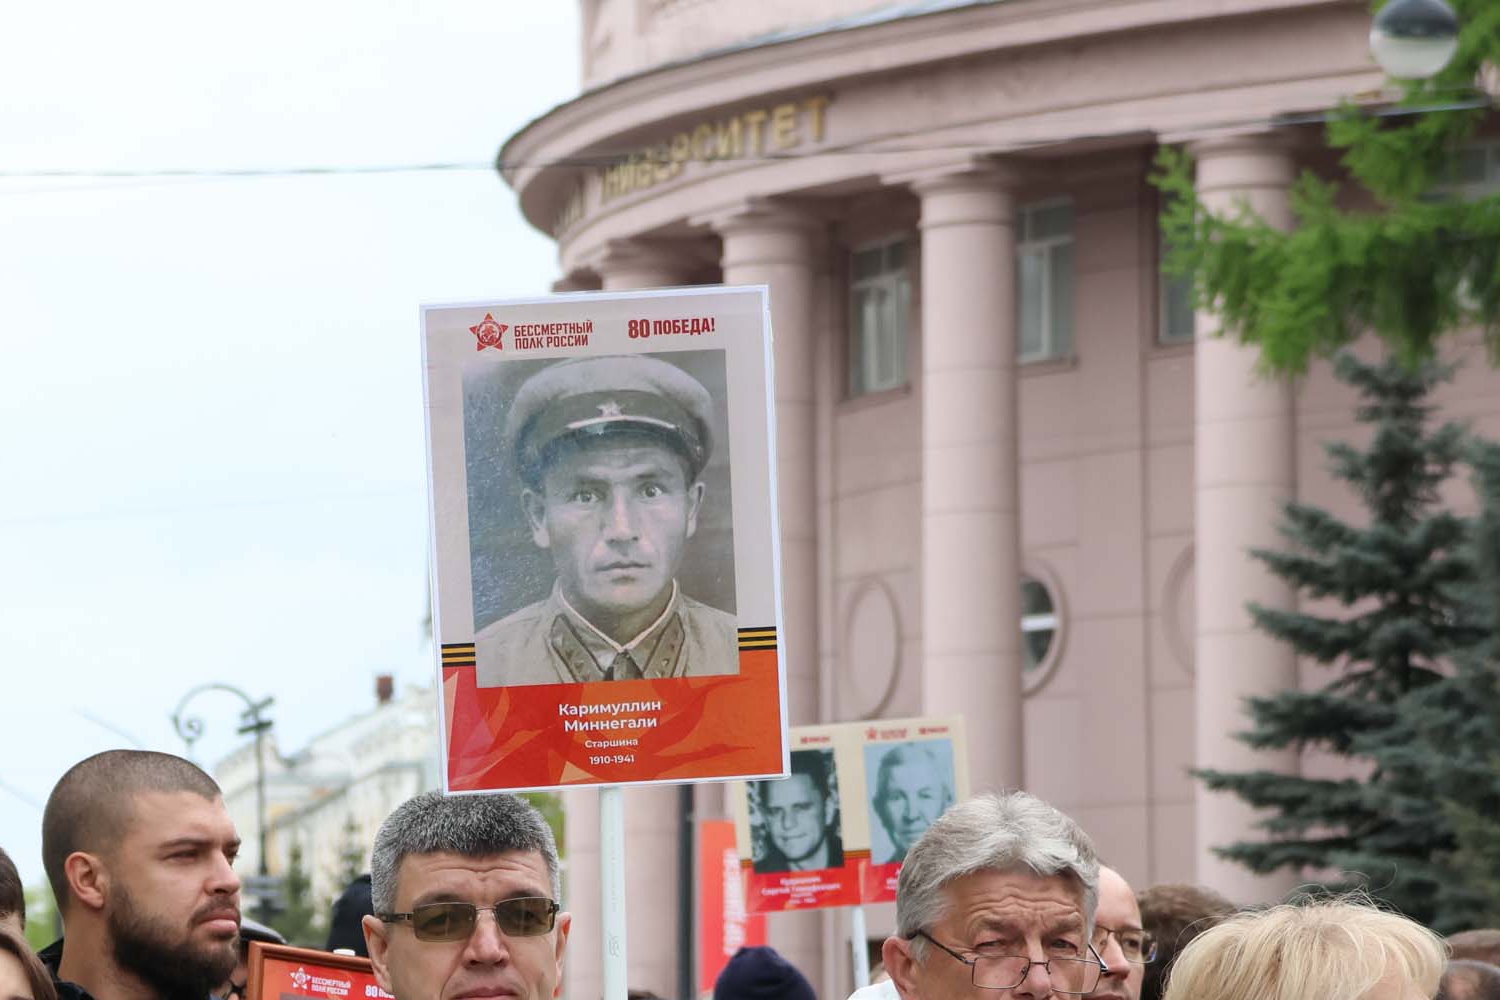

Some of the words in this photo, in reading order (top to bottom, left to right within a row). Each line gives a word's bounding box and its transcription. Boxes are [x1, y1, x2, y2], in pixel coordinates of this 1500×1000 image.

[514, 319, 593, 337] БЕССМЕРТНЫЙ
[628, 319, 650, 338] 80
[653, 317, 715, 335] ПОБЕДА!
[515, 336, 544, 350] ПОЛК
[547, 334, 589, 349] РОССИИ
[558, 700, 661, 717] Каримуллин
[564, 717, 657, 732] Миннегали
[585, 738, 638, 749] Старшина
[589, 754, 635, 765] 1910-1941
